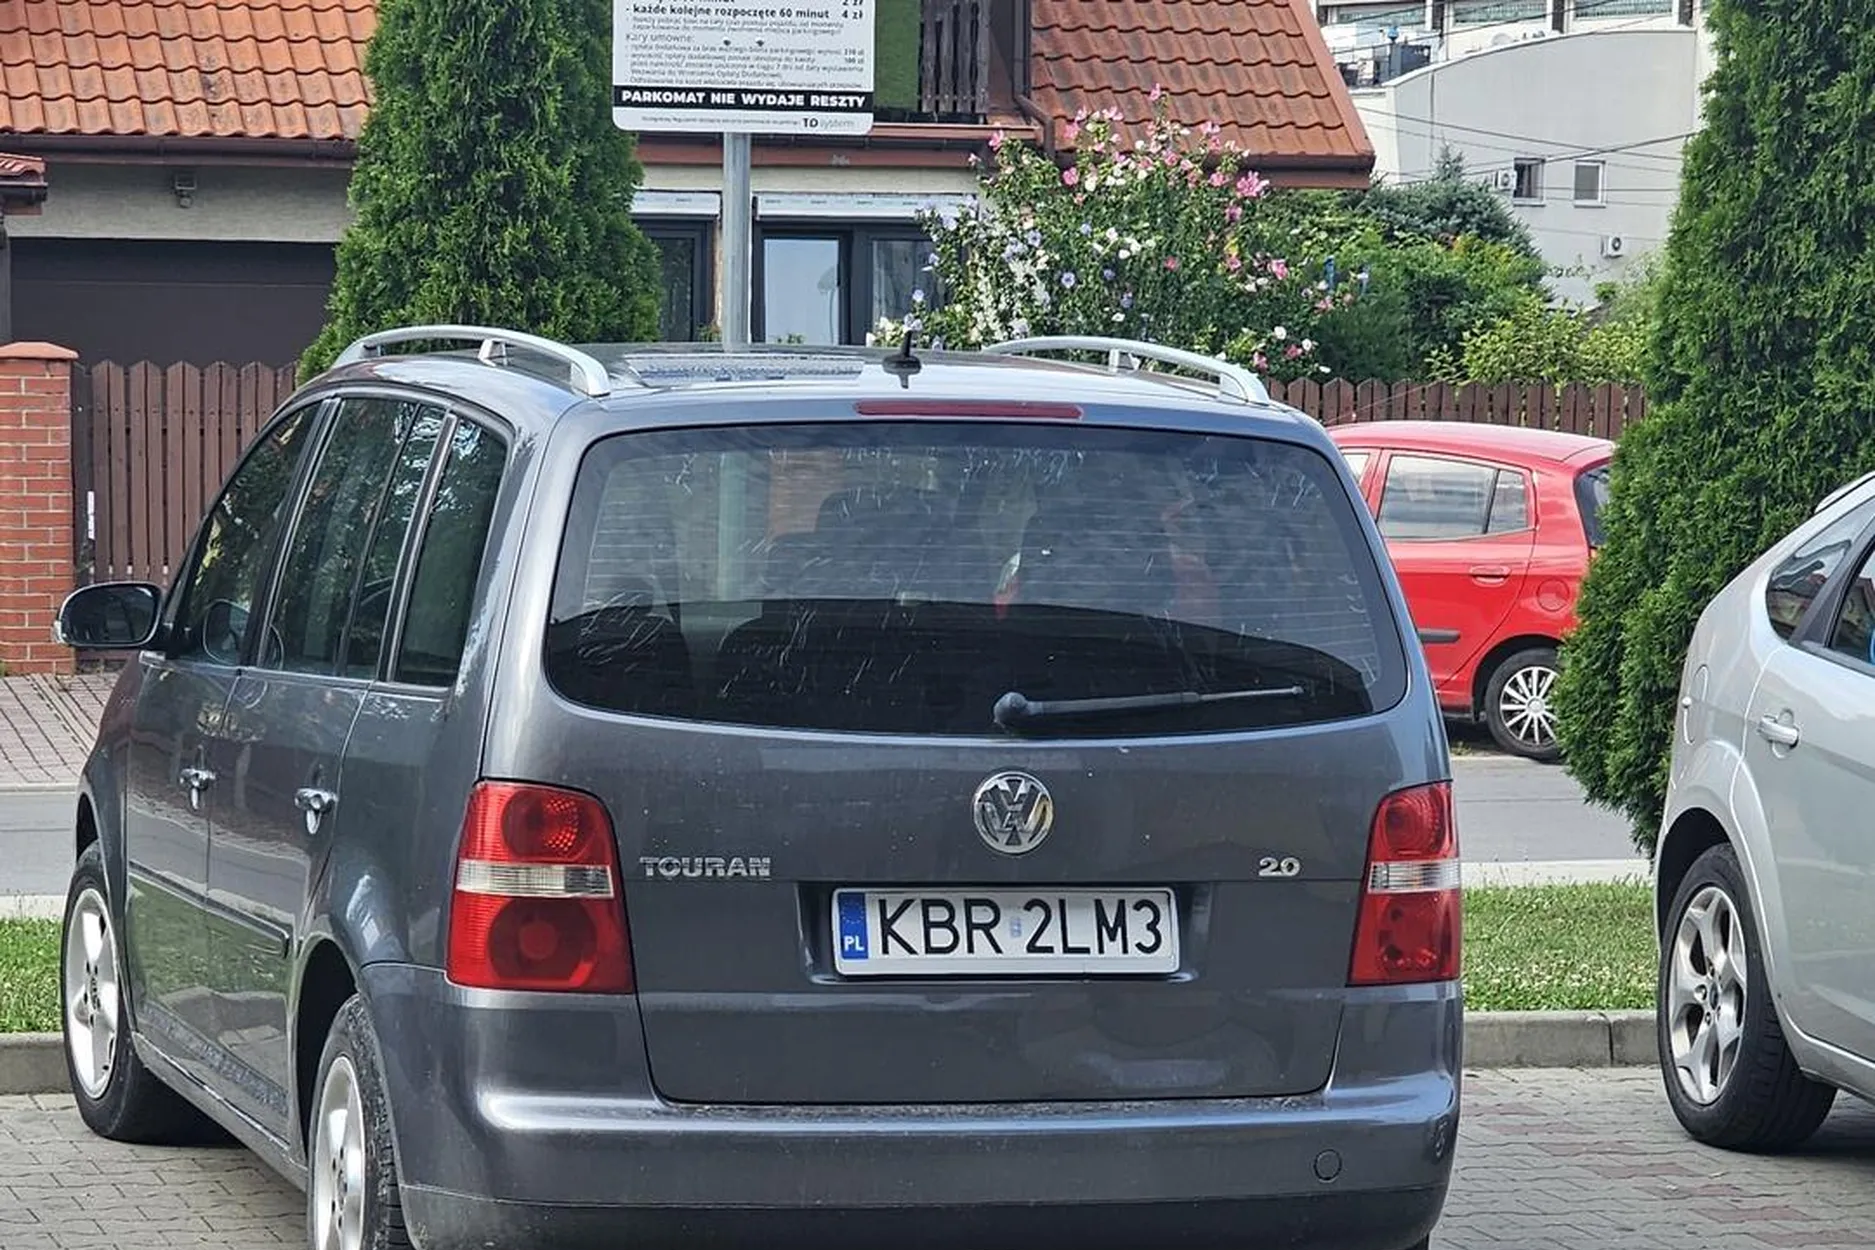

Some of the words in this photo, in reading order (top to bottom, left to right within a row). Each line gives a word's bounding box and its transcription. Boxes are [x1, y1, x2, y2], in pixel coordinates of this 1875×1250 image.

[633, 4, 667, 14] każde
[669, 5, 711, 17] kolejne
[715, 7, 776, 19] rozpoczęte
[779, 8, 792, 18] 60
[796, 9, 829, 19] minut
[841, 10, 848, 18] 4
[621, 90, 706, 104] PARKOMAT
[710, 92, 736, 105] NIE
[741, 93, 805, 107] WYDAJE
[810, 95, 865, 108] RESZTY
[639, 856, 771, 877] TOURAN
[878, 898, 1003, 955] KBR
[1023, 898, 1163, 955] 2LM3
[844, 936, 864, 951] PL
